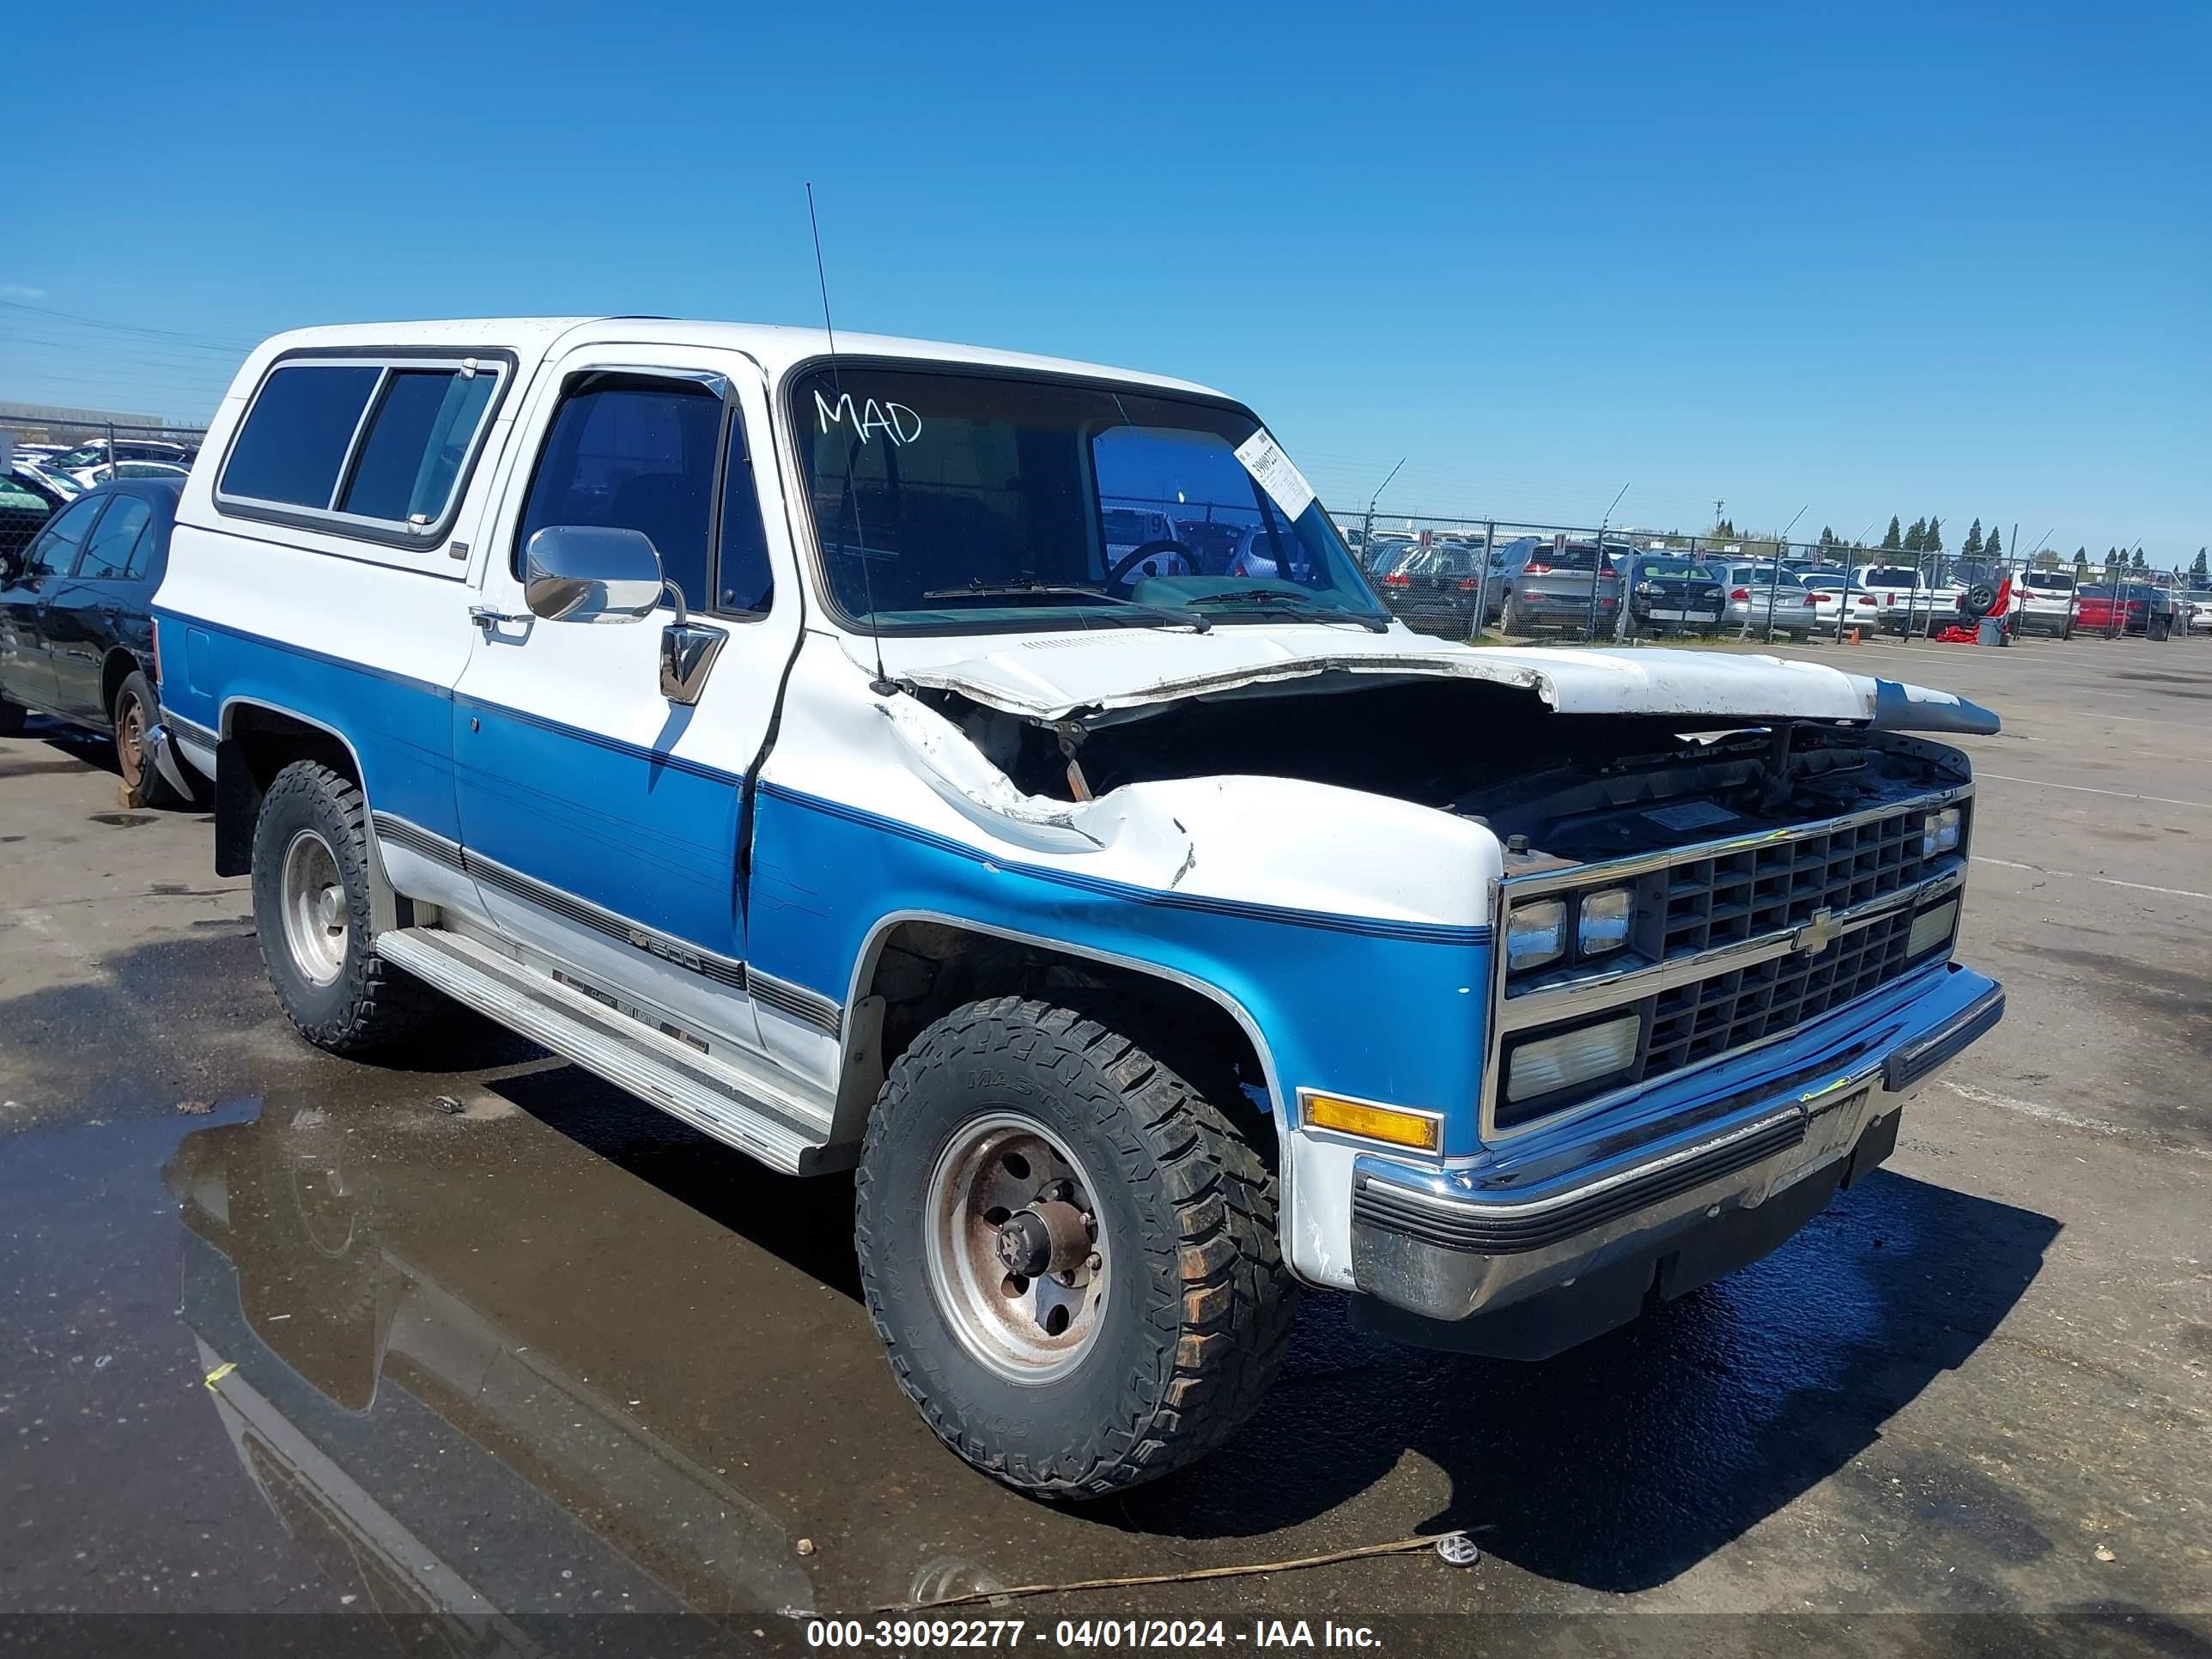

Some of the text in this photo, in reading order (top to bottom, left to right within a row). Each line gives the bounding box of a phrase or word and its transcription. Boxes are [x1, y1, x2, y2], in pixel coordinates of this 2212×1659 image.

[814, 390, 921, 447] MAD
[1421, 531, 1431, 546] 10
[591, 988, 616, 1006] CLASSIC
